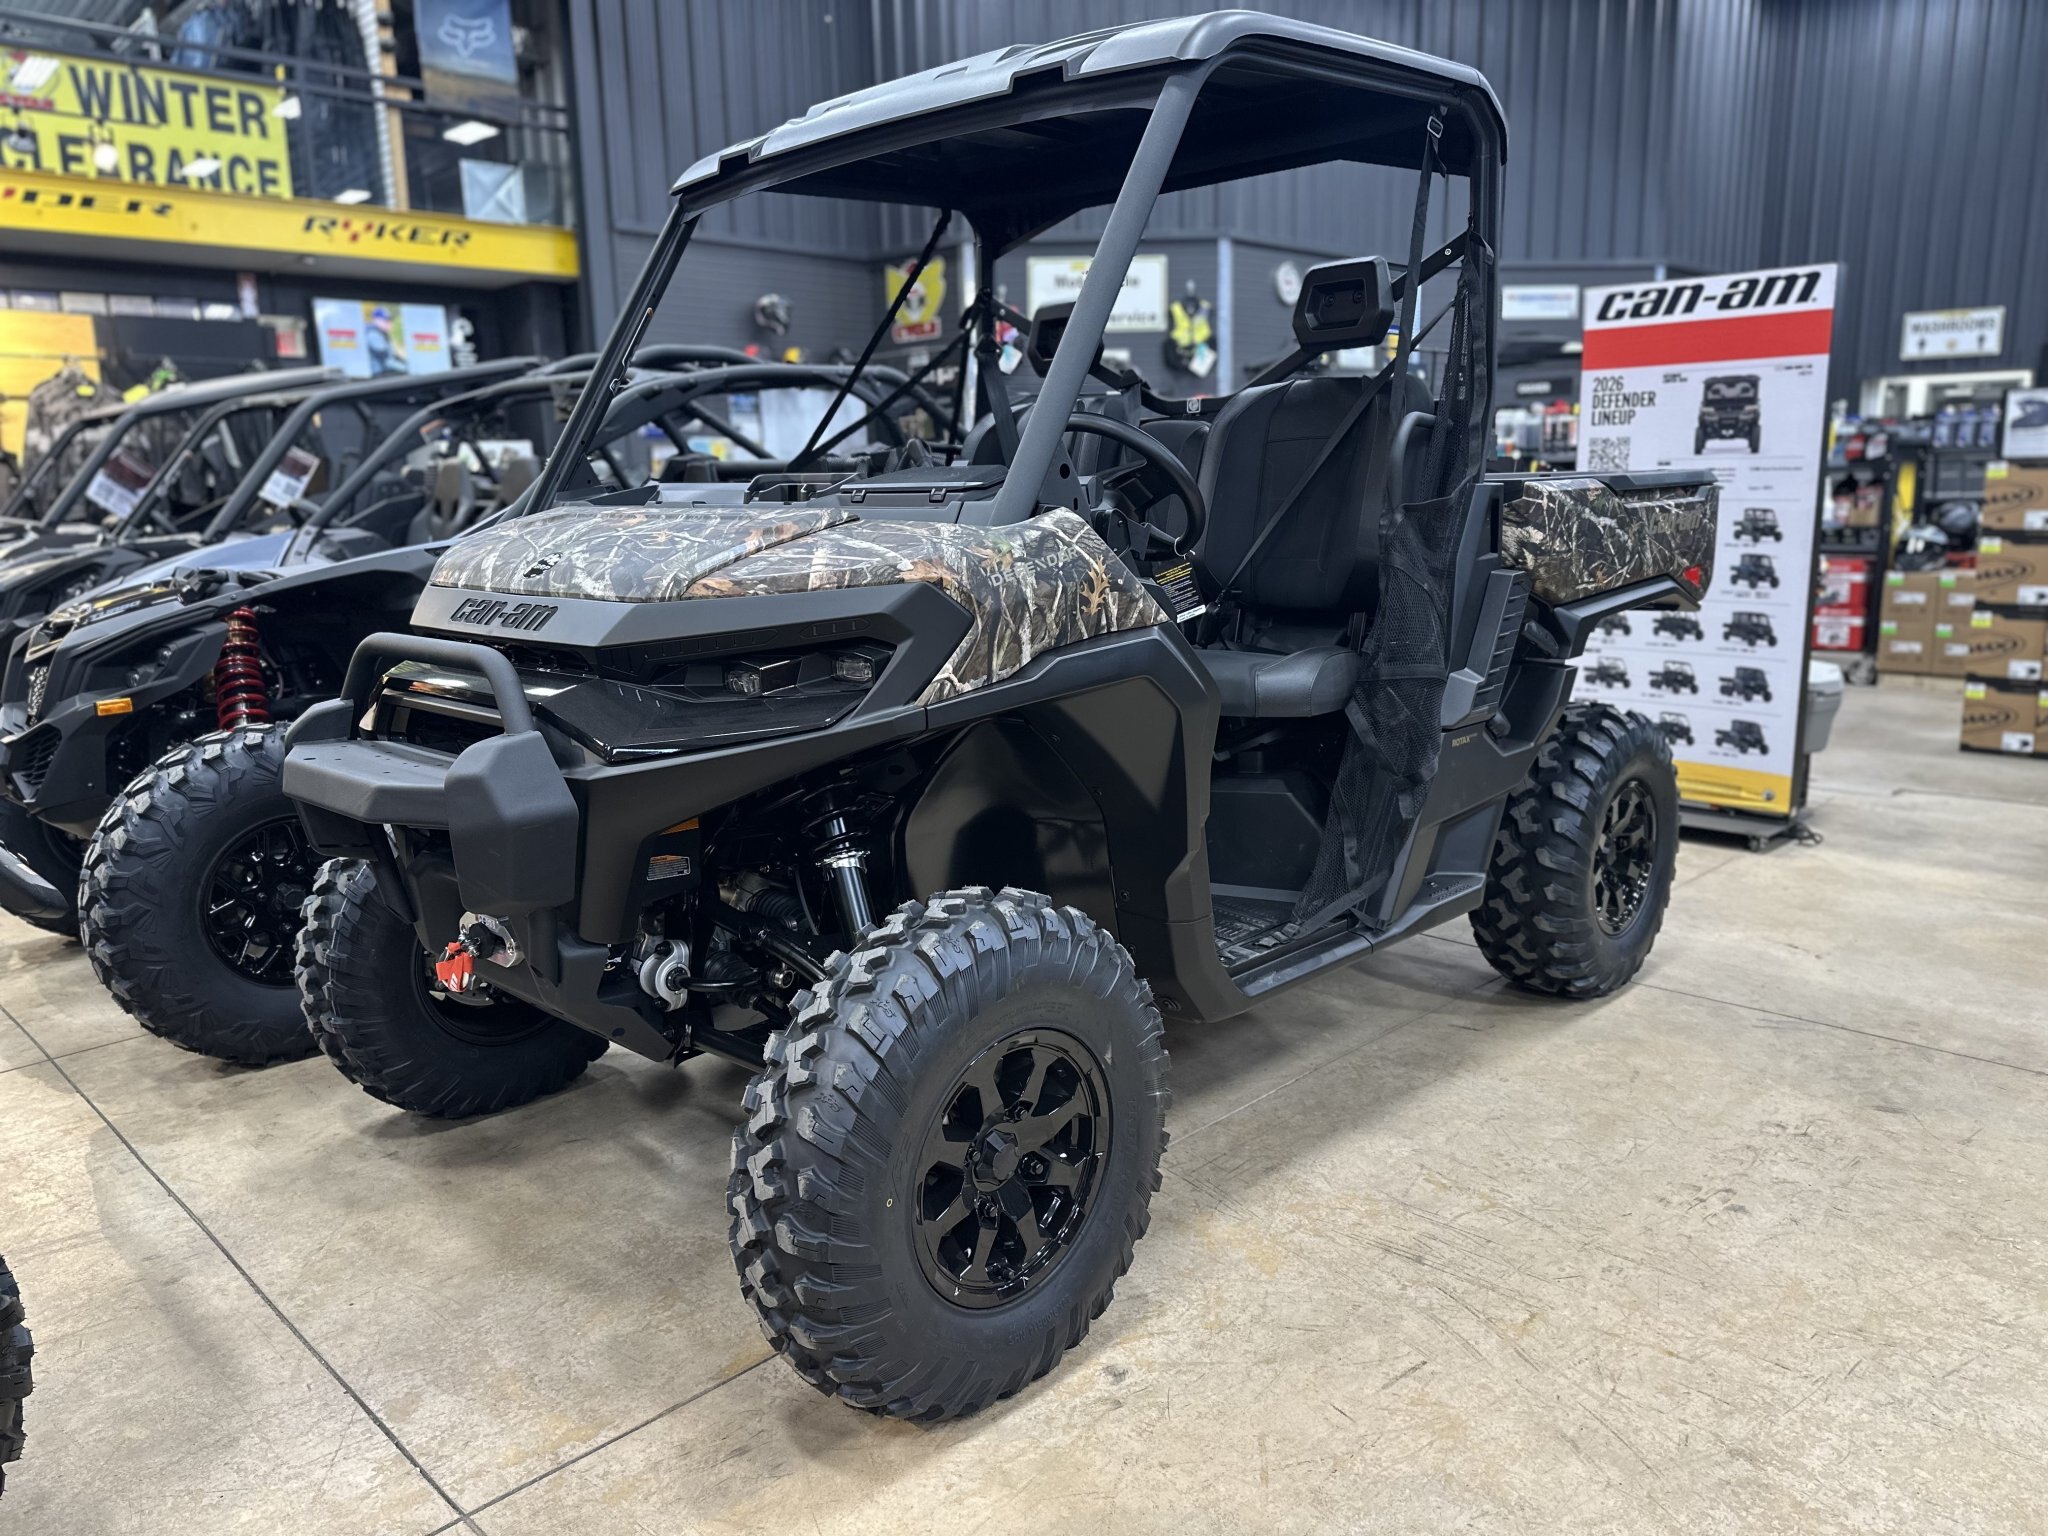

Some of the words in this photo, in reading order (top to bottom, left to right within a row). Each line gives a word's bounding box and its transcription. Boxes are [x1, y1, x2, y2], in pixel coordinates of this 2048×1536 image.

[69, 64, 268, 139] WINTER
[304, 214, 471, 248] RYKER
[1597, 271, 1822, 322] can-am
[1592, 391, 1657, 410] DEFENDER
[1593, 376, 1624, 392] 2026
[1591, 410, 1636, 427] LINEUP
[990, 546, 1078, 587] DEFENDER
[450, 597, 559, 632] can-am
